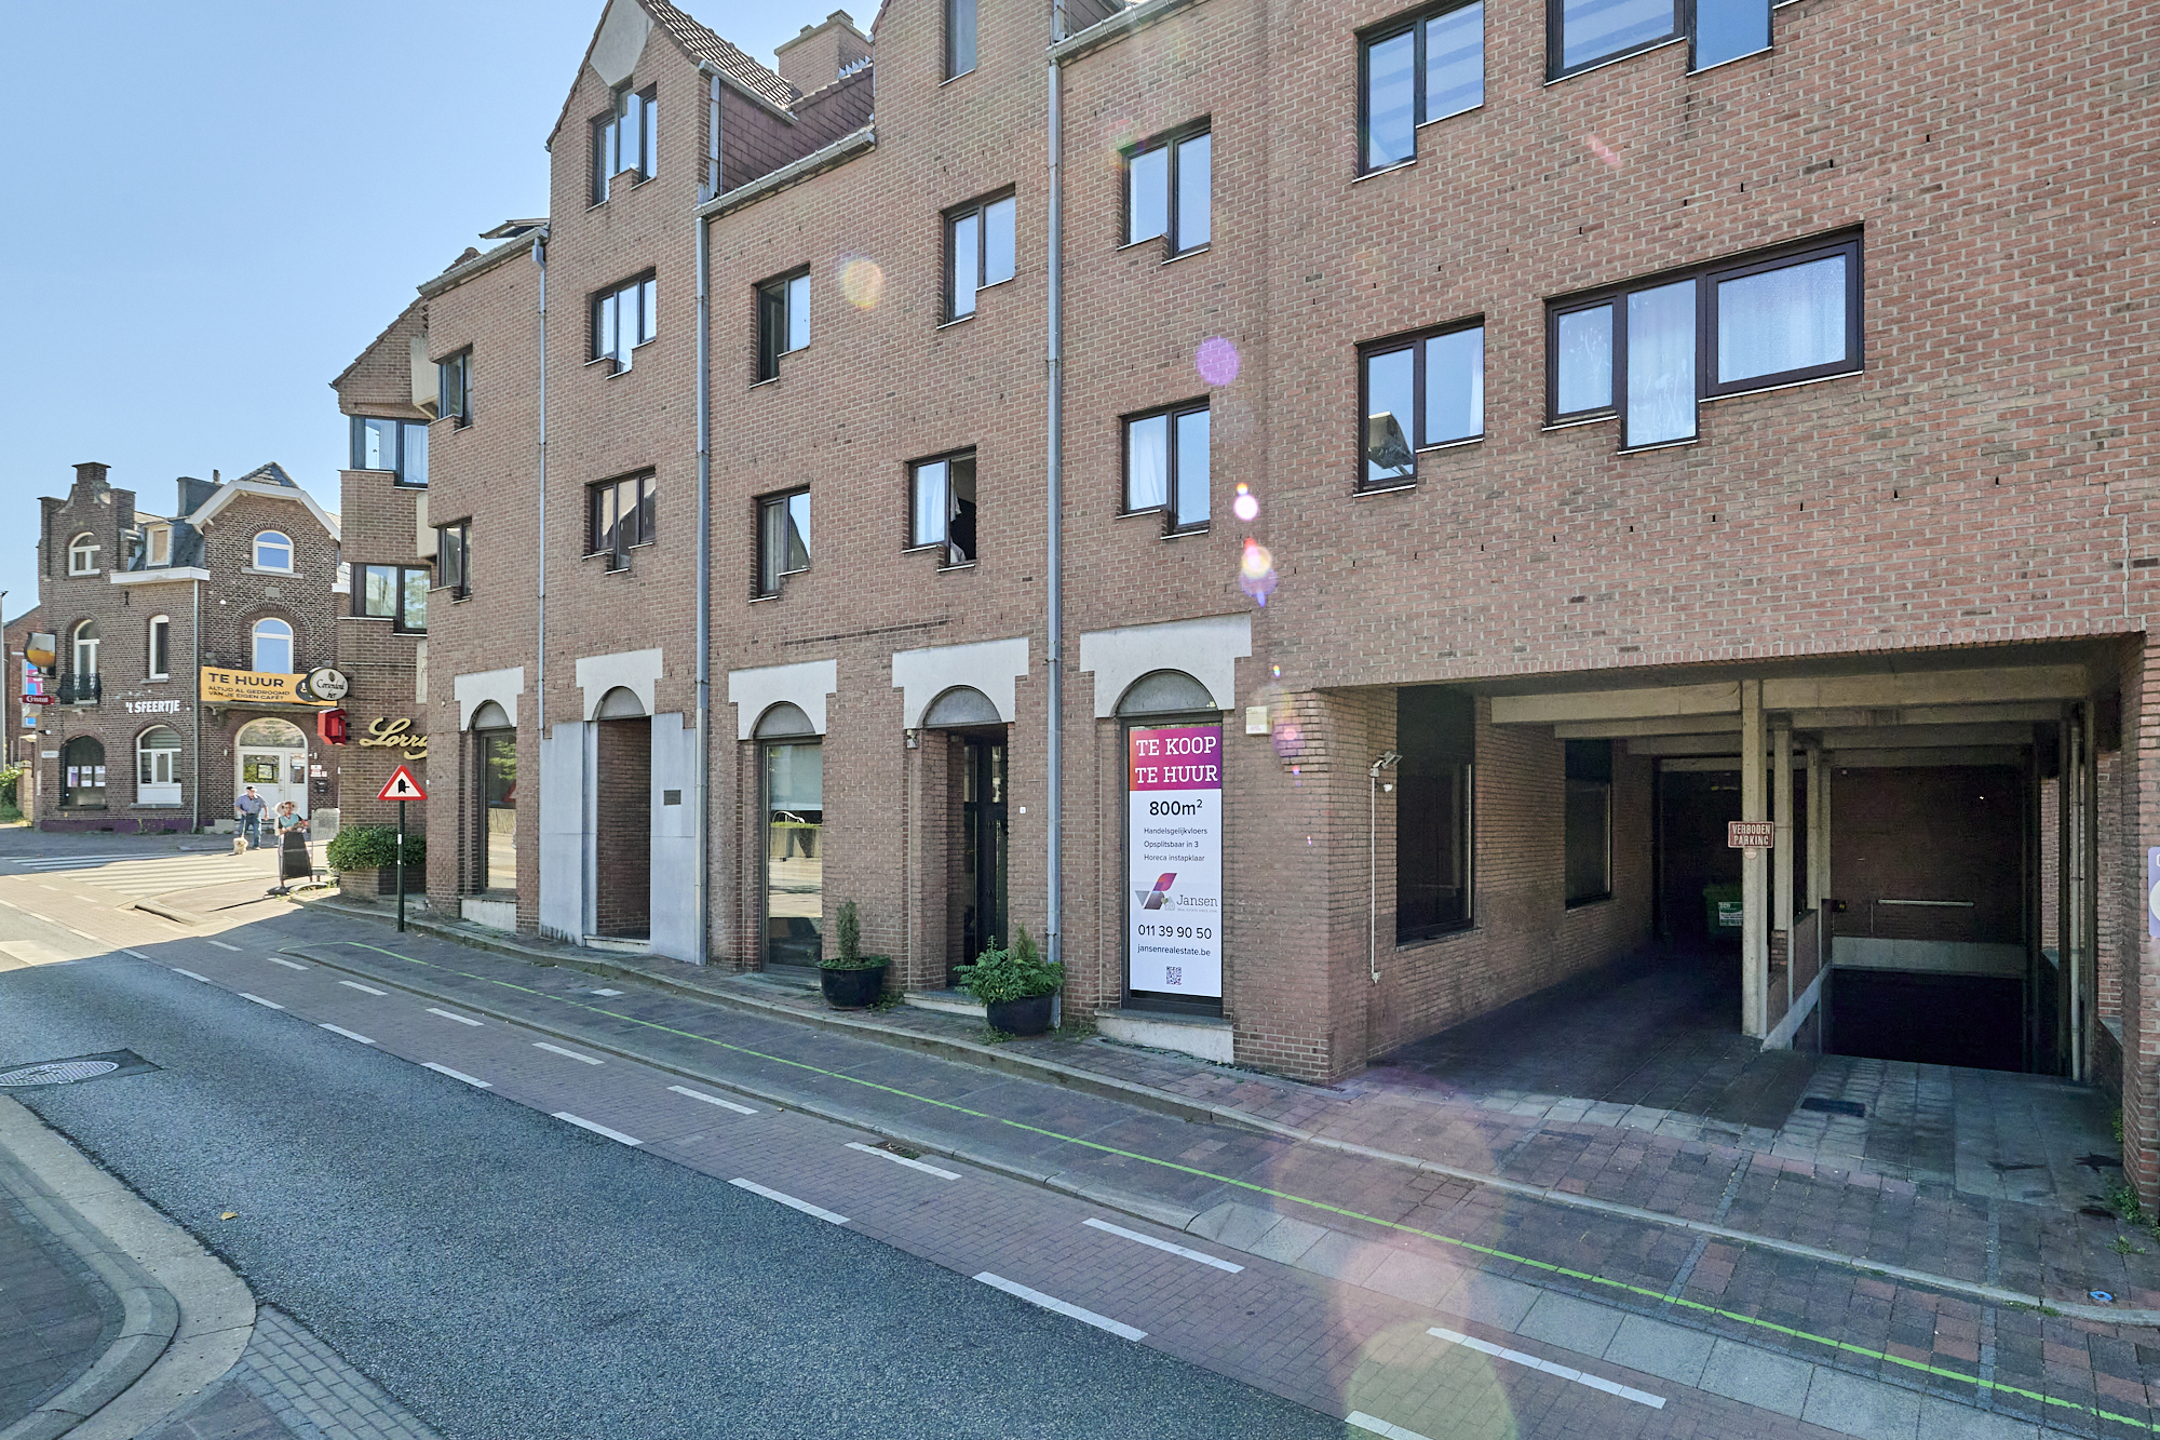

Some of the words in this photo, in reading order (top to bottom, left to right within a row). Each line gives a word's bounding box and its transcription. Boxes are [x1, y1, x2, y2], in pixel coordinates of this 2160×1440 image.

[208, 672, 230, 684] TE
[235, 675, 284, 688] HUUR
[246, 688, 290, 696] GEDROOMD
[134, 700, 180, 714] SFEERTJE
[1136, 739, 1159, 756] TE
[1165, 736, 1216, 755] KOOP
[1135, 767, 1158, 783] TE
[1163, 765, 1218, 782] HUUR
[1143, 827, 1208, 835] Handelsgelijkvloers
[1732, 825, 1770, 834] VERBODEN
[1143, 840, 1185, 848] Opsplitsbaar
[1186, 840, 1193, 848] in
[1194, 840, 1199, 848] 3
[1734, 835, 1768, 845] PARKING
[1168, 854, 1205, 862] instapklaar
[1176, 894, 1218, 907] Jansen
[1137, 924, 1155, 936] 011
[1158, 925, 1173, 937] 39
[1176, 926, 1192, 938] 90
[1196, 927, 1212, 939] 50
[1137, 943, 1211, 956] jansenrealestate.be
